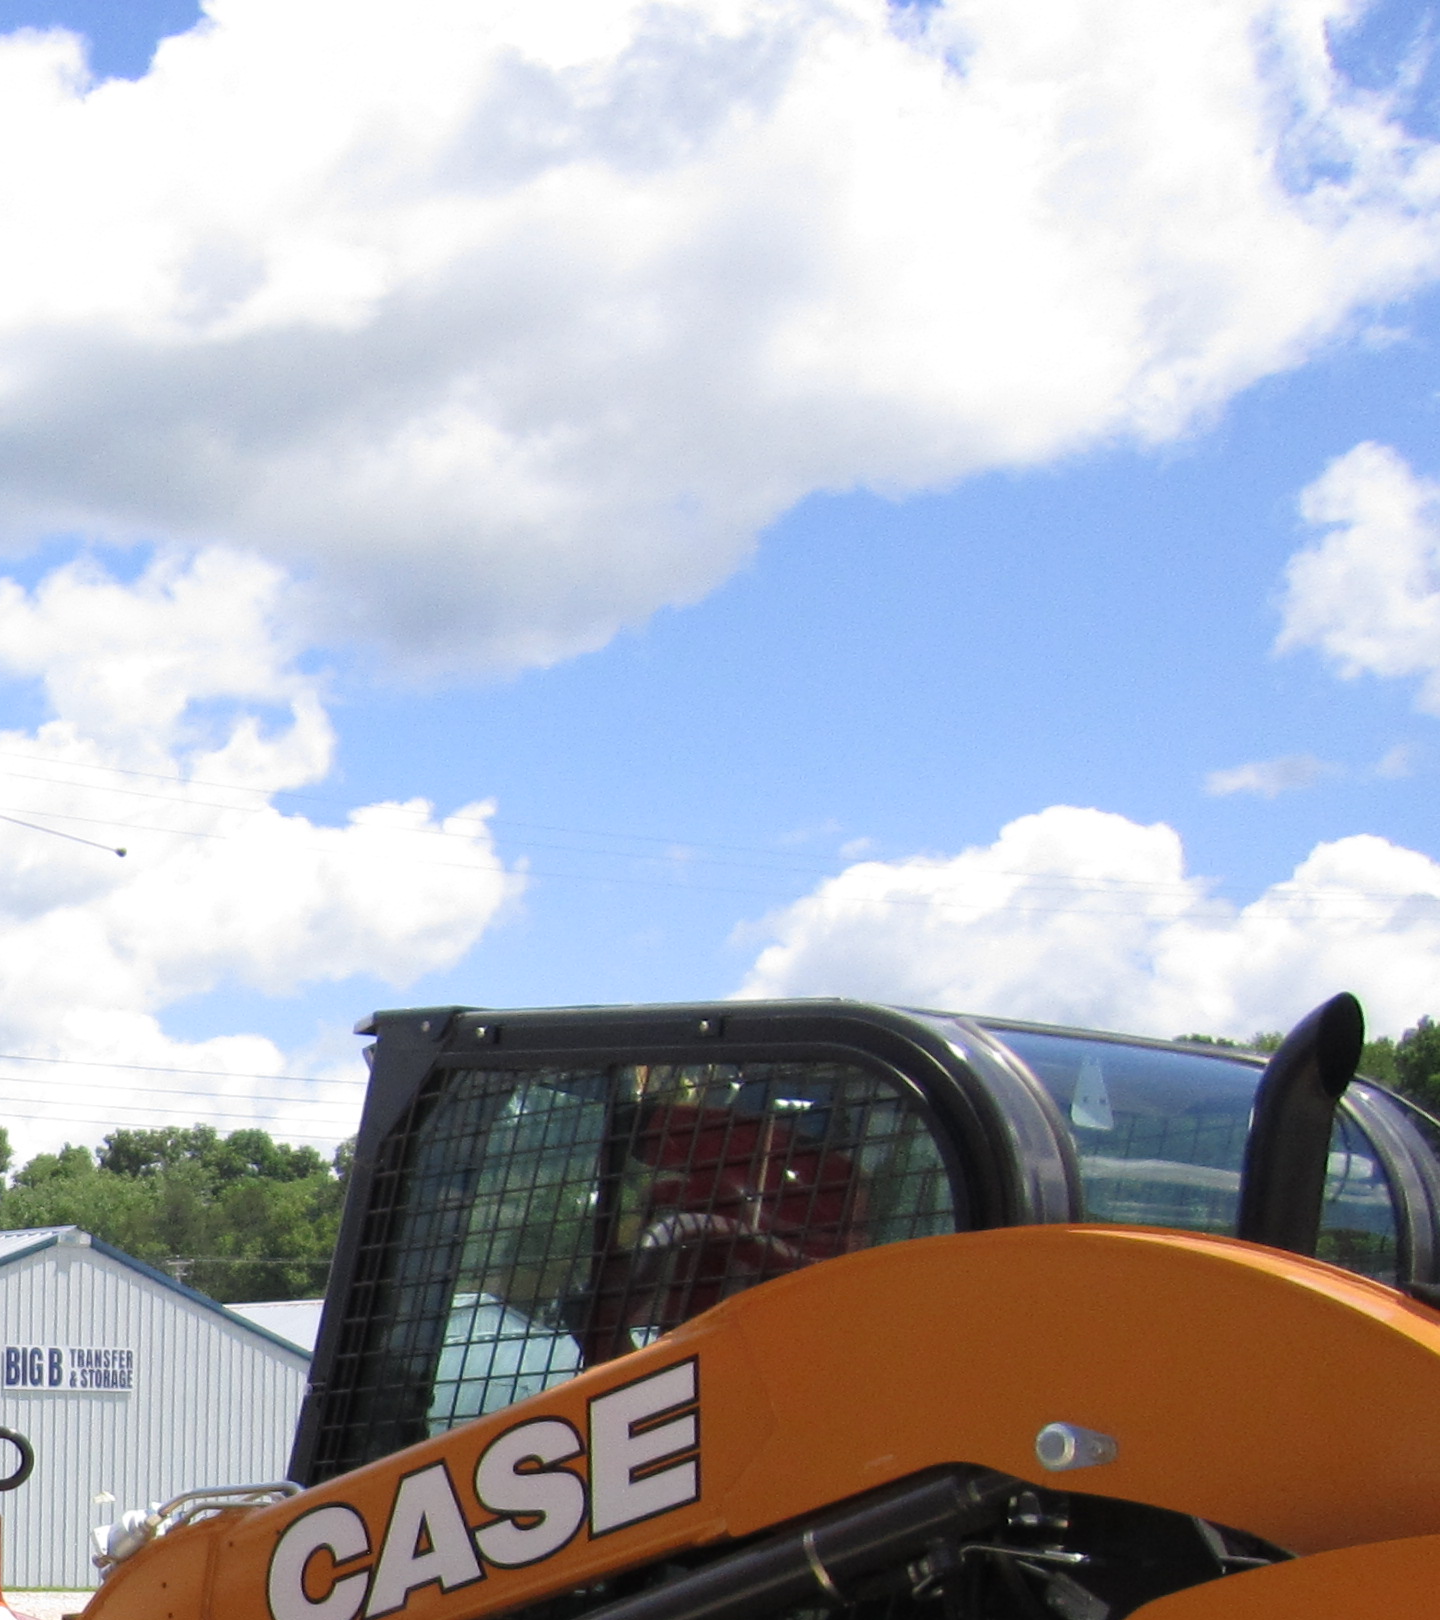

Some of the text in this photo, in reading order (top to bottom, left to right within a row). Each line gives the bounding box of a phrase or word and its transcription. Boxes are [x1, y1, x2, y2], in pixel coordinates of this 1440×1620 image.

[5, 1346, 63, 1387] BIG B
[69, 1348, 133, 1369] TRANSFER
[69, 1369, 133, 1388] & STORAGE
